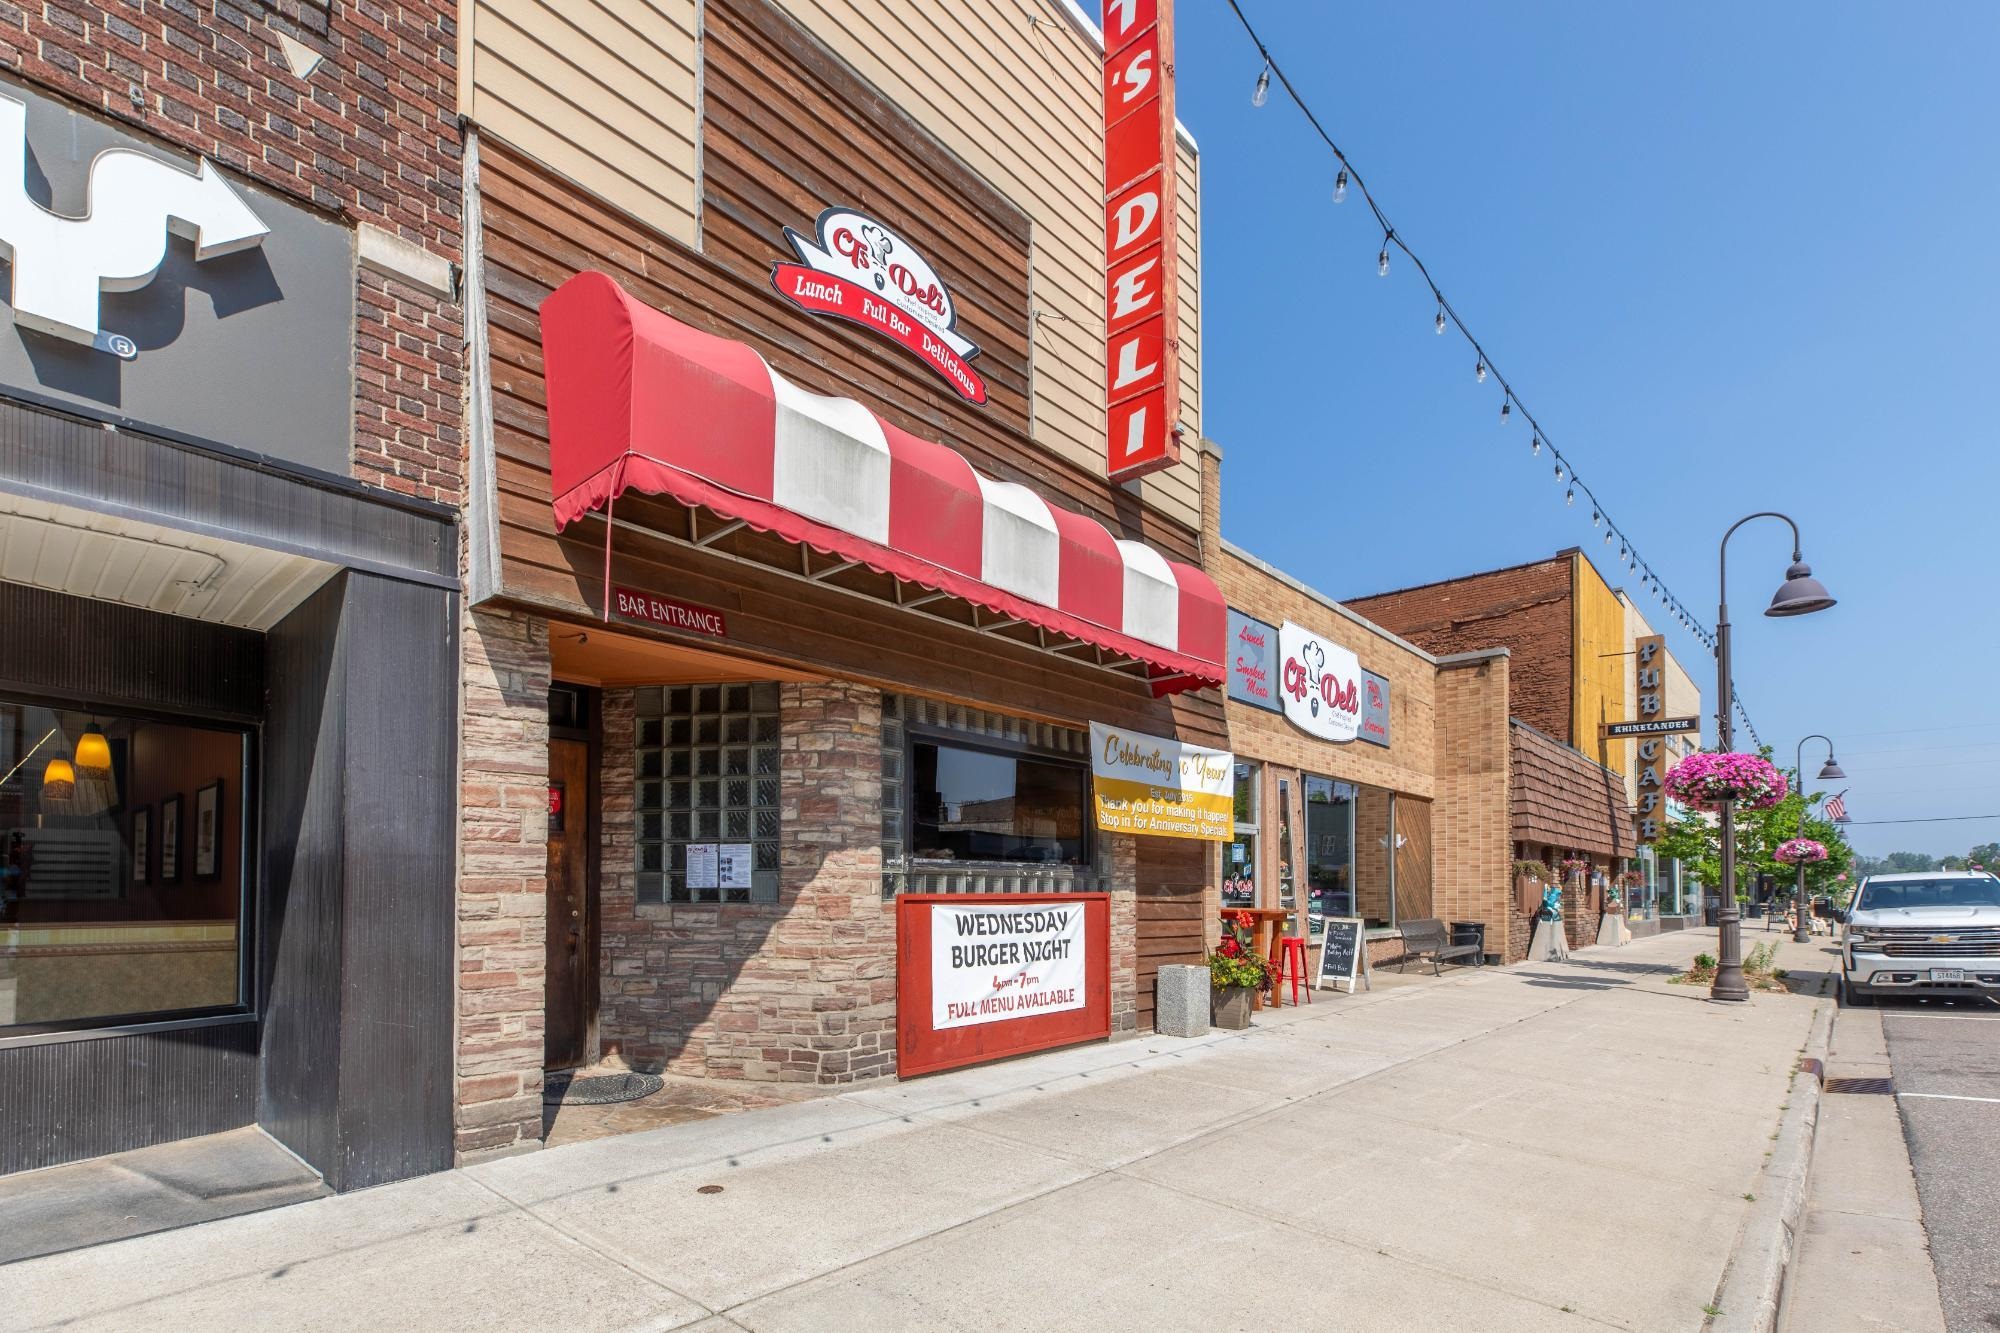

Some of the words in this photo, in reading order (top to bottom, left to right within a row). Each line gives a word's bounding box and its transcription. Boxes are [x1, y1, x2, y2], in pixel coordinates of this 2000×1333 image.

[794, 275, 842, 304] Lunch
[862, 298, 886, 325] Full
[889, 313, 911, 337] Bar
[888, 263, 946, 316] Deli
[1112, 191, 1159, 457] DELI
[619, 593, 648, 617] BAR
[651, 601, 723, 633] ENTRANCE
[1239, 624, 1265, 648] Lunch
[1235, 656, 1266, 681] Smoked
[1638, 643, 1660, 714] PUB
[1320, 673, 1358, 715] Deli
[1614, 720, 1689, 733] RHINELANDER
[1104, 734, 1172, 781] Celebrating
[1639, 739, 1662, 838] CAFE
[1100, 793, 1128, 811] Thank
[1131, 802, 1149, 815] you
[1151, 800, 1164, 815] for
[1166, 805, 1195, 822] making
[1197, 807, 1203, 819] it
[1100, 811, 1119, 828] Stop
[1121, 814, 1131, 827] in
[1134, 815, 1147, 829] for
[1150, 817, 1199, 836] Anniversary
[955, 911, 1068, 936] WEDNESDAY
[952, 943, 1020, 968] BURGER
[1023, 939, 1071, 962] NIGHT
[948, 1002, 977, 1019] FULL
[980, 997, 1014, 1015] MENU
[1017, 988, 1075, 1010] AVAILABLE
